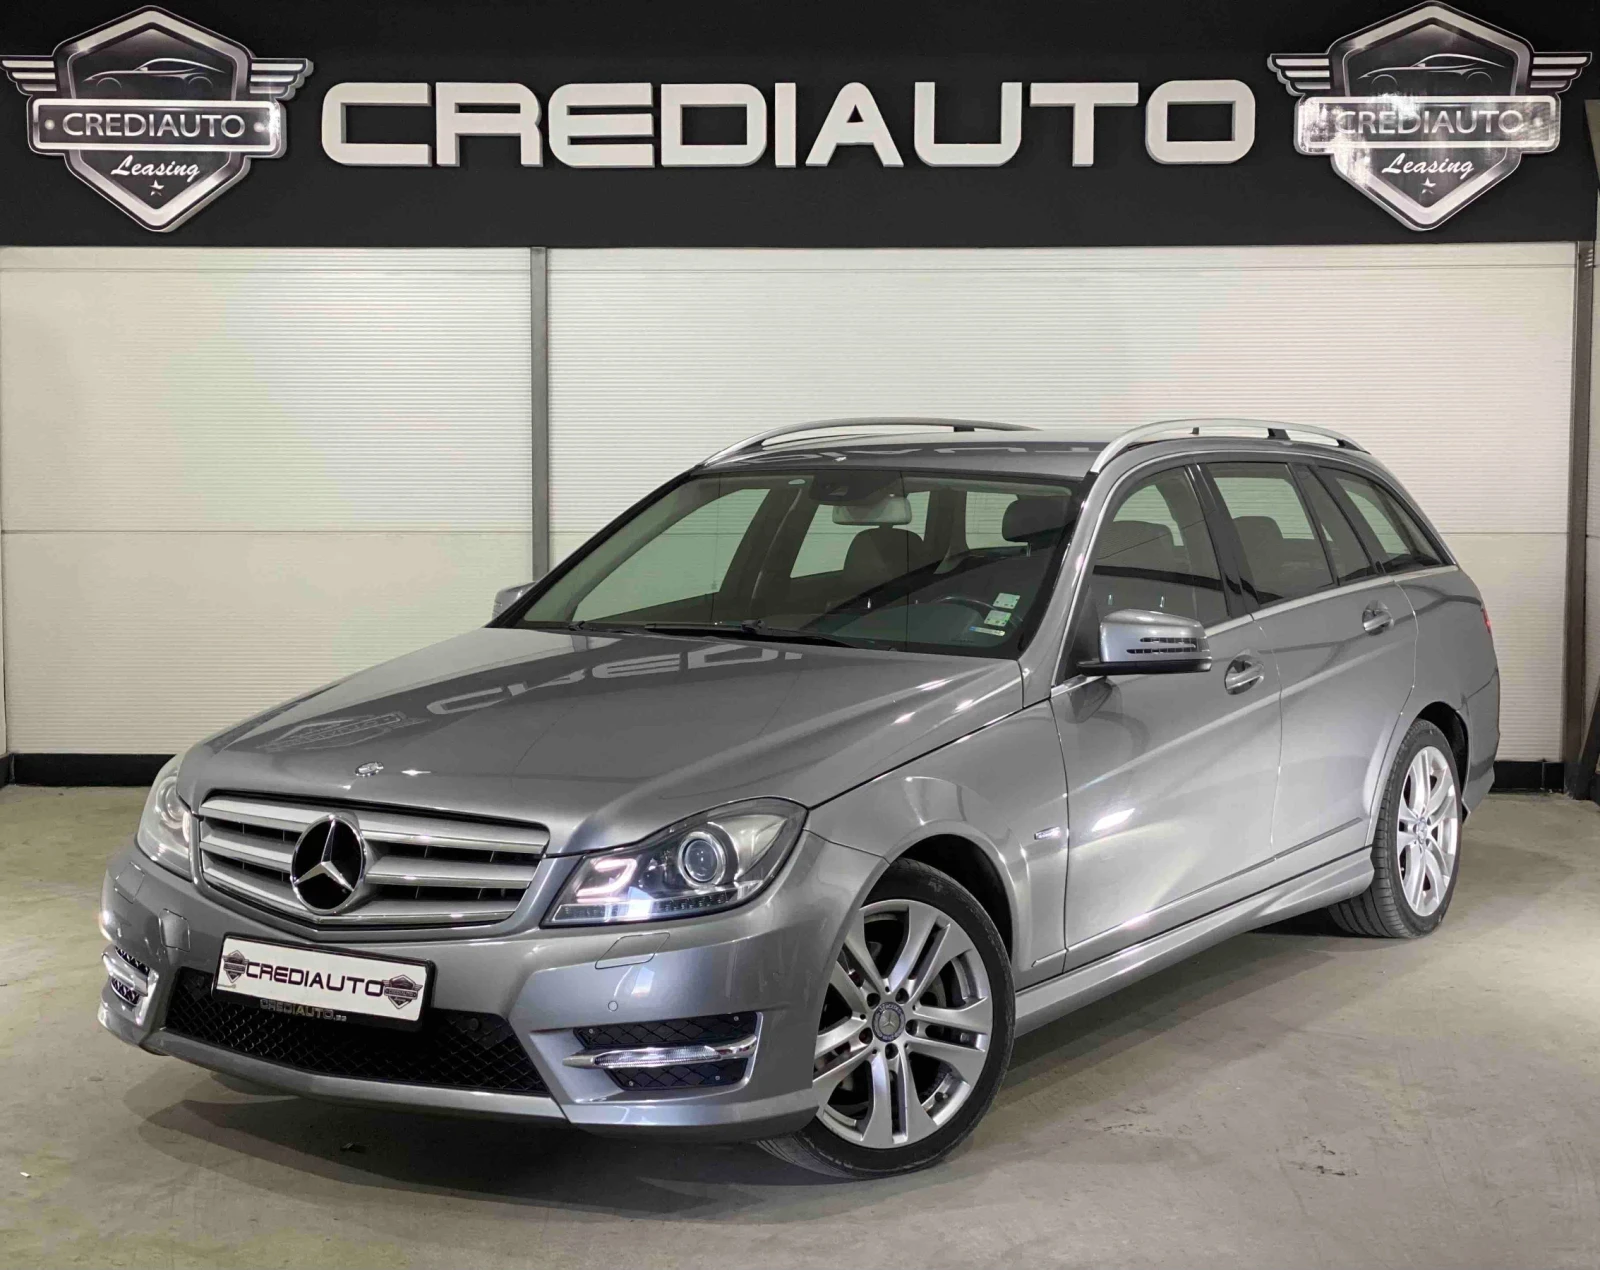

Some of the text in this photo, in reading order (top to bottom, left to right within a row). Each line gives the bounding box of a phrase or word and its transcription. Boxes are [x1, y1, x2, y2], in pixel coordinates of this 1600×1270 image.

[62, 112, 246, 138] CREDIAUTO
[322, 79, 1255, 168] CREDIAUTO
[1335, 109, 1524, 135] CREDIAUTO
[110, 154, 201, 183] Leasing
[1381, 152, 1475, 181] Leasing
[245, 961, 385, 998] CREDIAUTO
